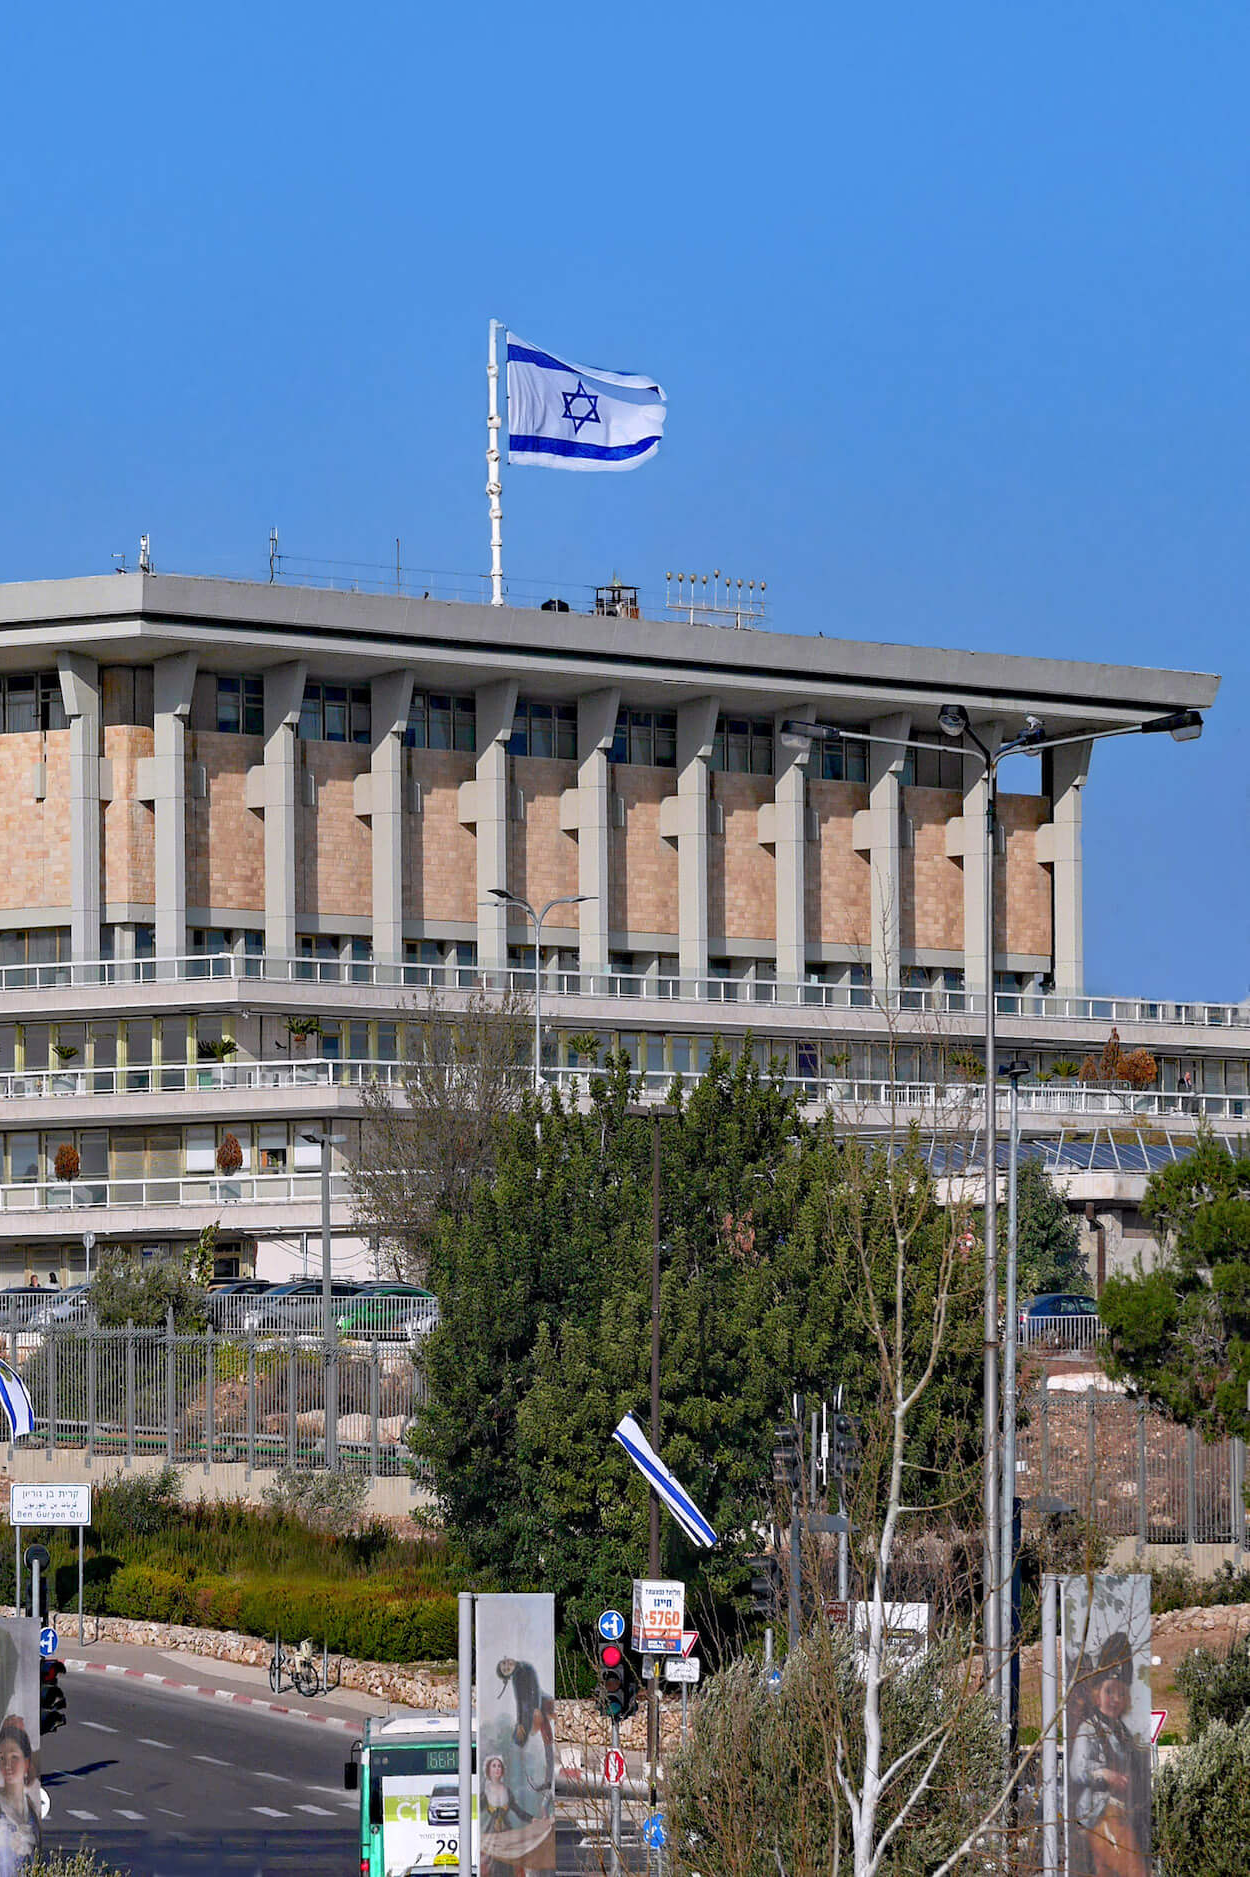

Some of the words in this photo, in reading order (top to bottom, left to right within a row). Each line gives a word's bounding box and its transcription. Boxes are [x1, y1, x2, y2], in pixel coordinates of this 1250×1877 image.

[22, 1490, 43, 1499] גוריון
[46, 1490, 55, 1500] בן
[58, 1490, 79, 1500] קרית
[17, 1510, 33, 1518] Ben
[396, 1801, 422, 1822] C1
